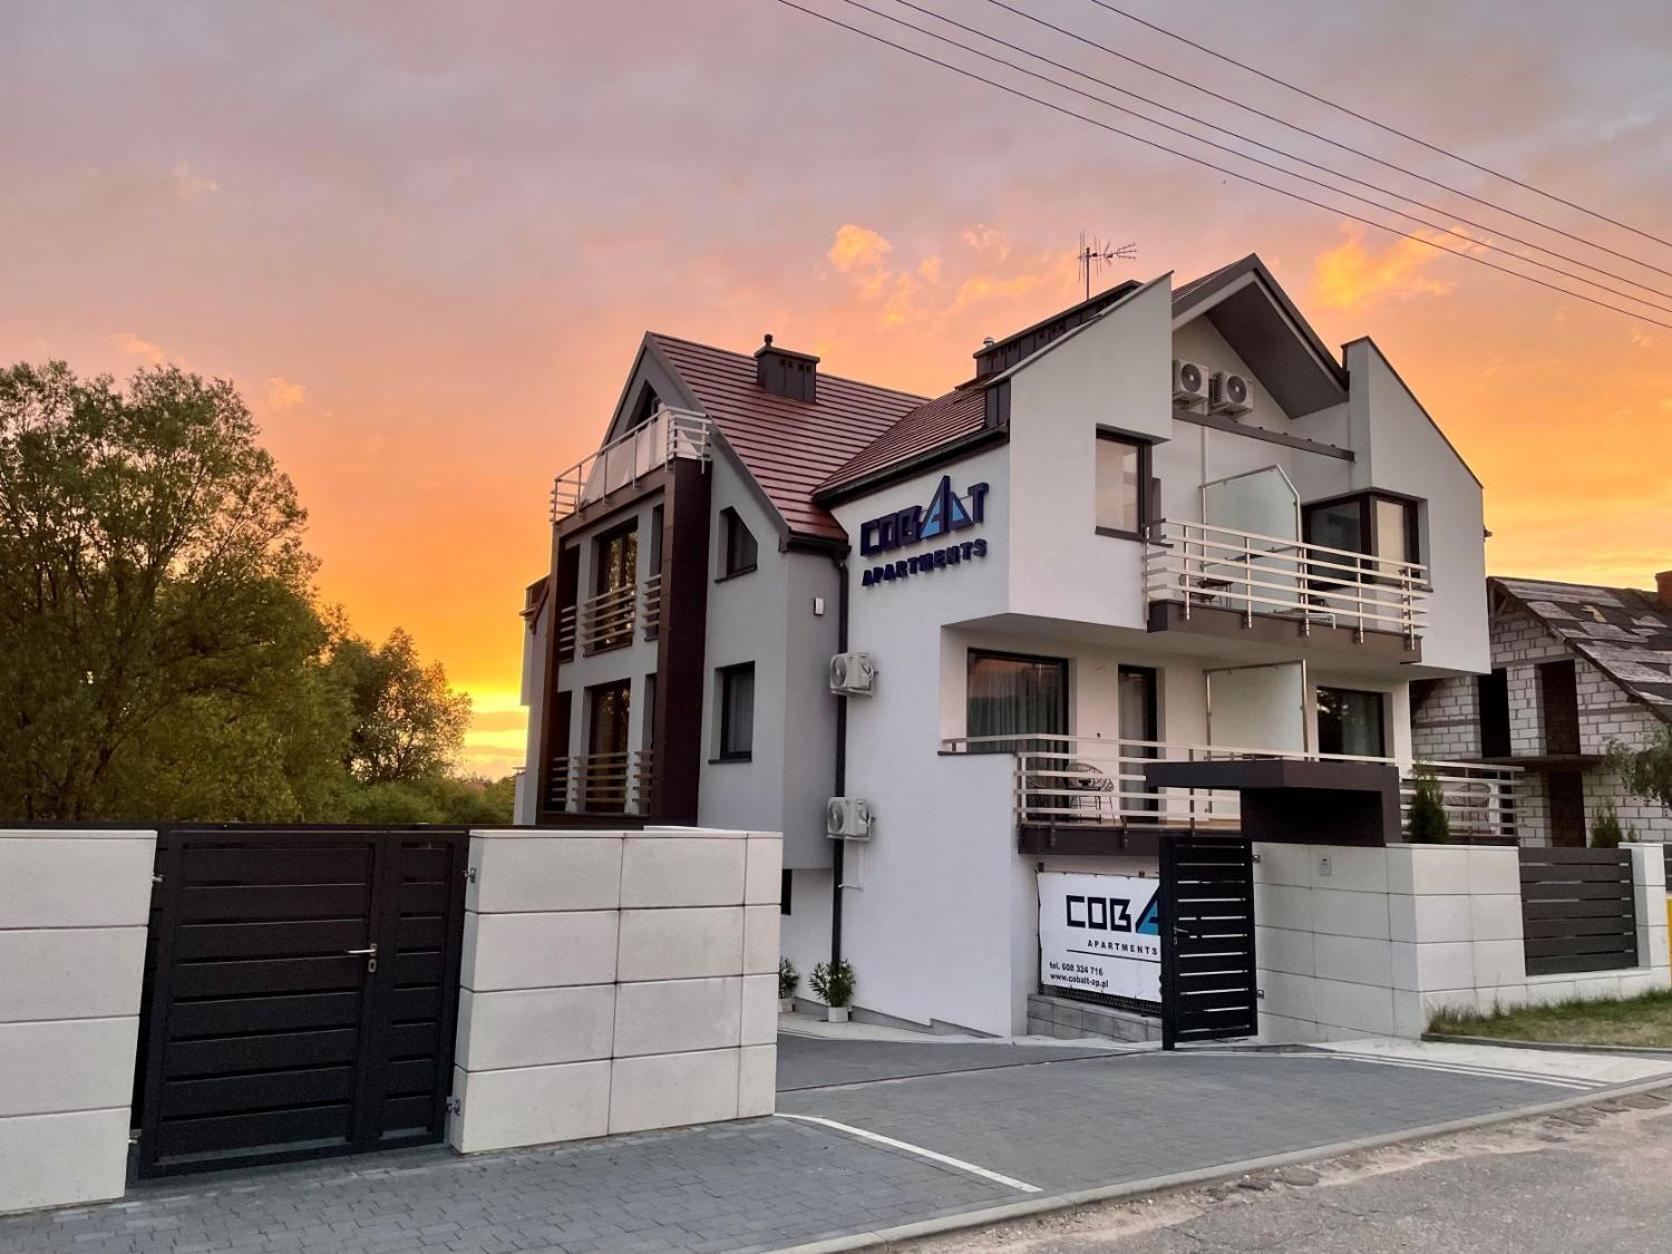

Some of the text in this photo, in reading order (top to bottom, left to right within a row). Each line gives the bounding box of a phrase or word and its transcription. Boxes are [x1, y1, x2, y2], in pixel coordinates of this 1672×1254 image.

[860, 475, 990, 557] COBALT
[862, 538, 988, 586] APARTMENTS
[1087, 939, 1158, 956] APARTMENTS
[1076, 964, 1089, 974] 324
[1090, 966, 1104, 977] 716
